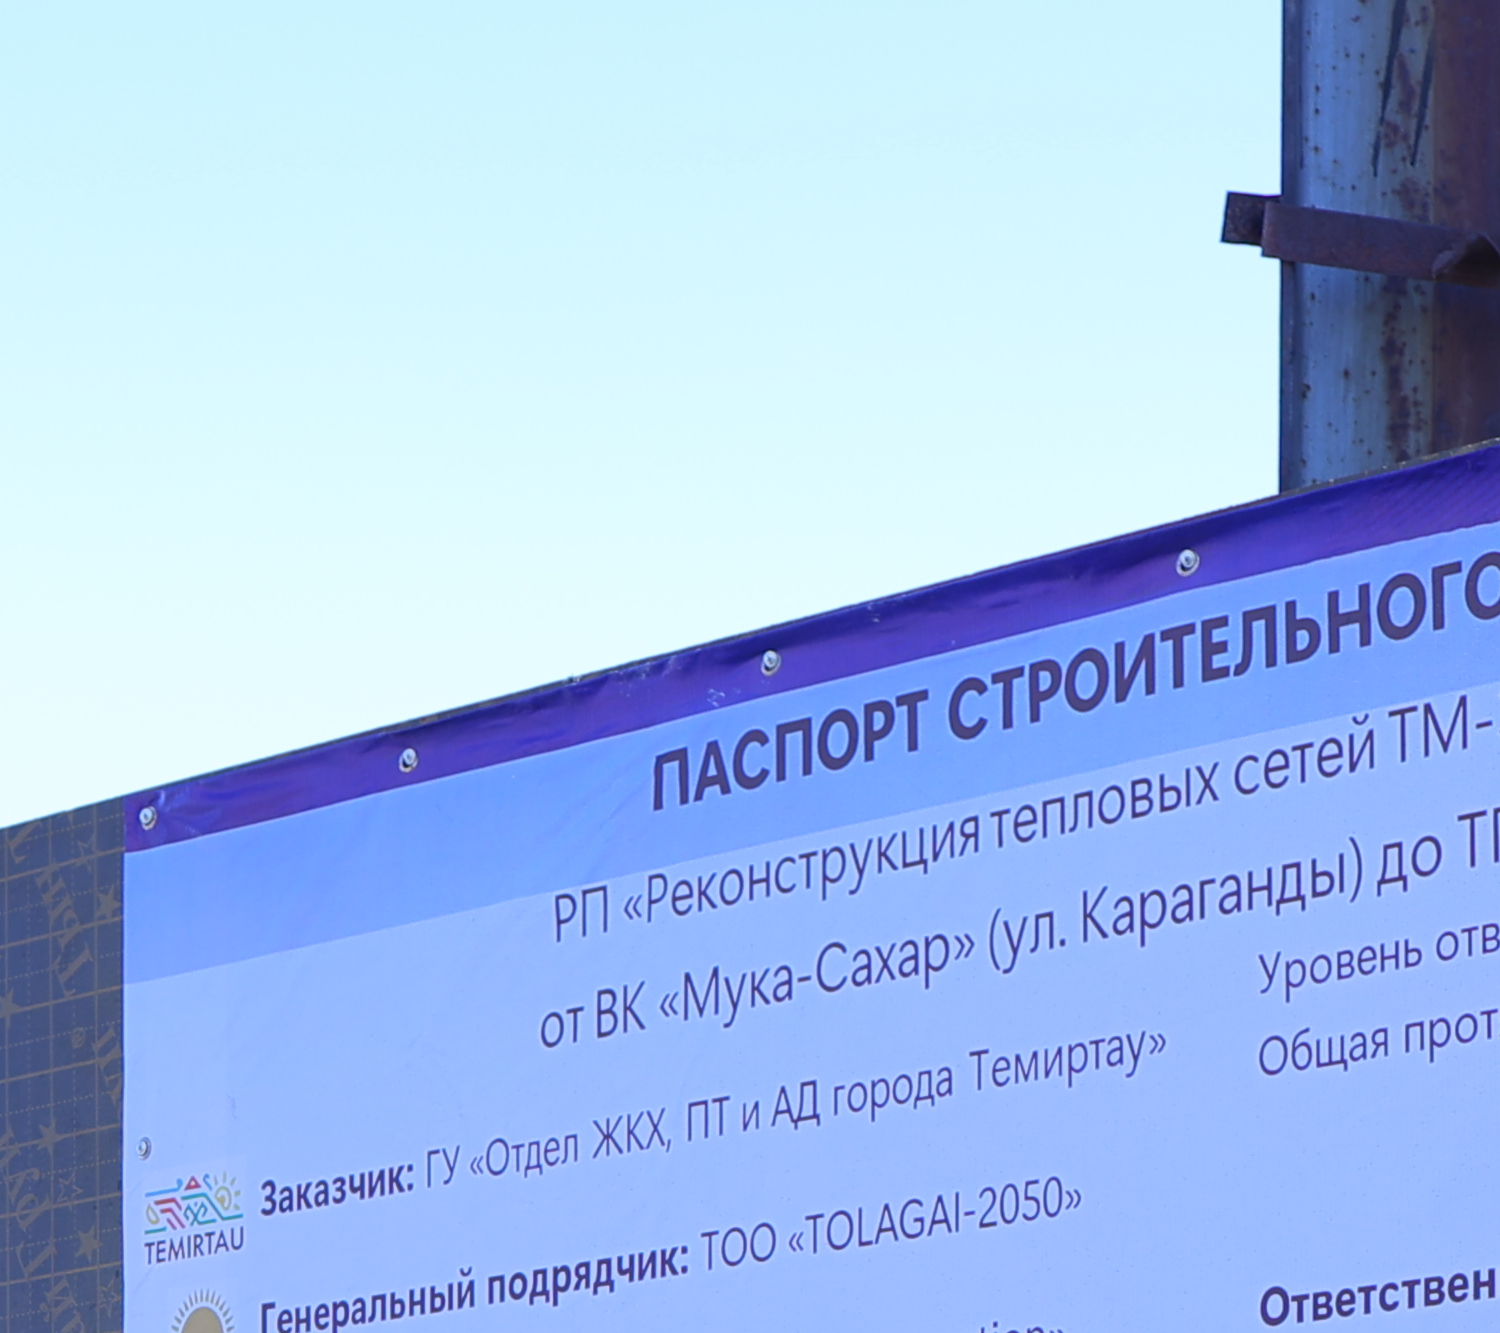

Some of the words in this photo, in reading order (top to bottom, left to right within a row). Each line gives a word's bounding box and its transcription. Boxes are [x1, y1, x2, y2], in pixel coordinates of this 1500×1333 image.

[653, 688, 929, 812] ПАСПОРТ
[555, 885, 608, 942] РП
[624, 815, 979, 923] «Реконструкция
[990, 762, 1219, 848] тепловых
[1234, 713, 1375, 795] сетей
[541, 1006, 584, 1048] от
[597, 981, 646, 1039] ВК
[660, 933, 975, 1028] «Мука-Сахар»
[989, 909, 1066, 974] (ул.
[1082, 837, 1363, 947] Караганды)
[1377, 835, 1442, 897] до
[1258, 939, 1422, 1003] Уровень
[1259, 1027, 1388, 1076] Общая
[261, 1164, 414, 1216] Заказчик:
[427, 1146, 460, 1187] ГУ
[470, 1133, 578, 1178] «Отдел
[593, 1108, 671, 1159] ЖКХ,
[687, 1095, 731, 1141] ПТ
[742, 1101, 760, 1131] и
[771, 1079, 821, 1130] АД
[833, 1067, 953, 1122] города
[969, 1031, 1166, 1090] Темиртау»
[145, 1226, 244, 1264] TEMIRTAU
[488, 1246, 688, 1307] подрядчик:
[701, 1222, 776, 1270] ТОО
[789, 1176, 1082, 1253] «TOLAGAI-2050»
